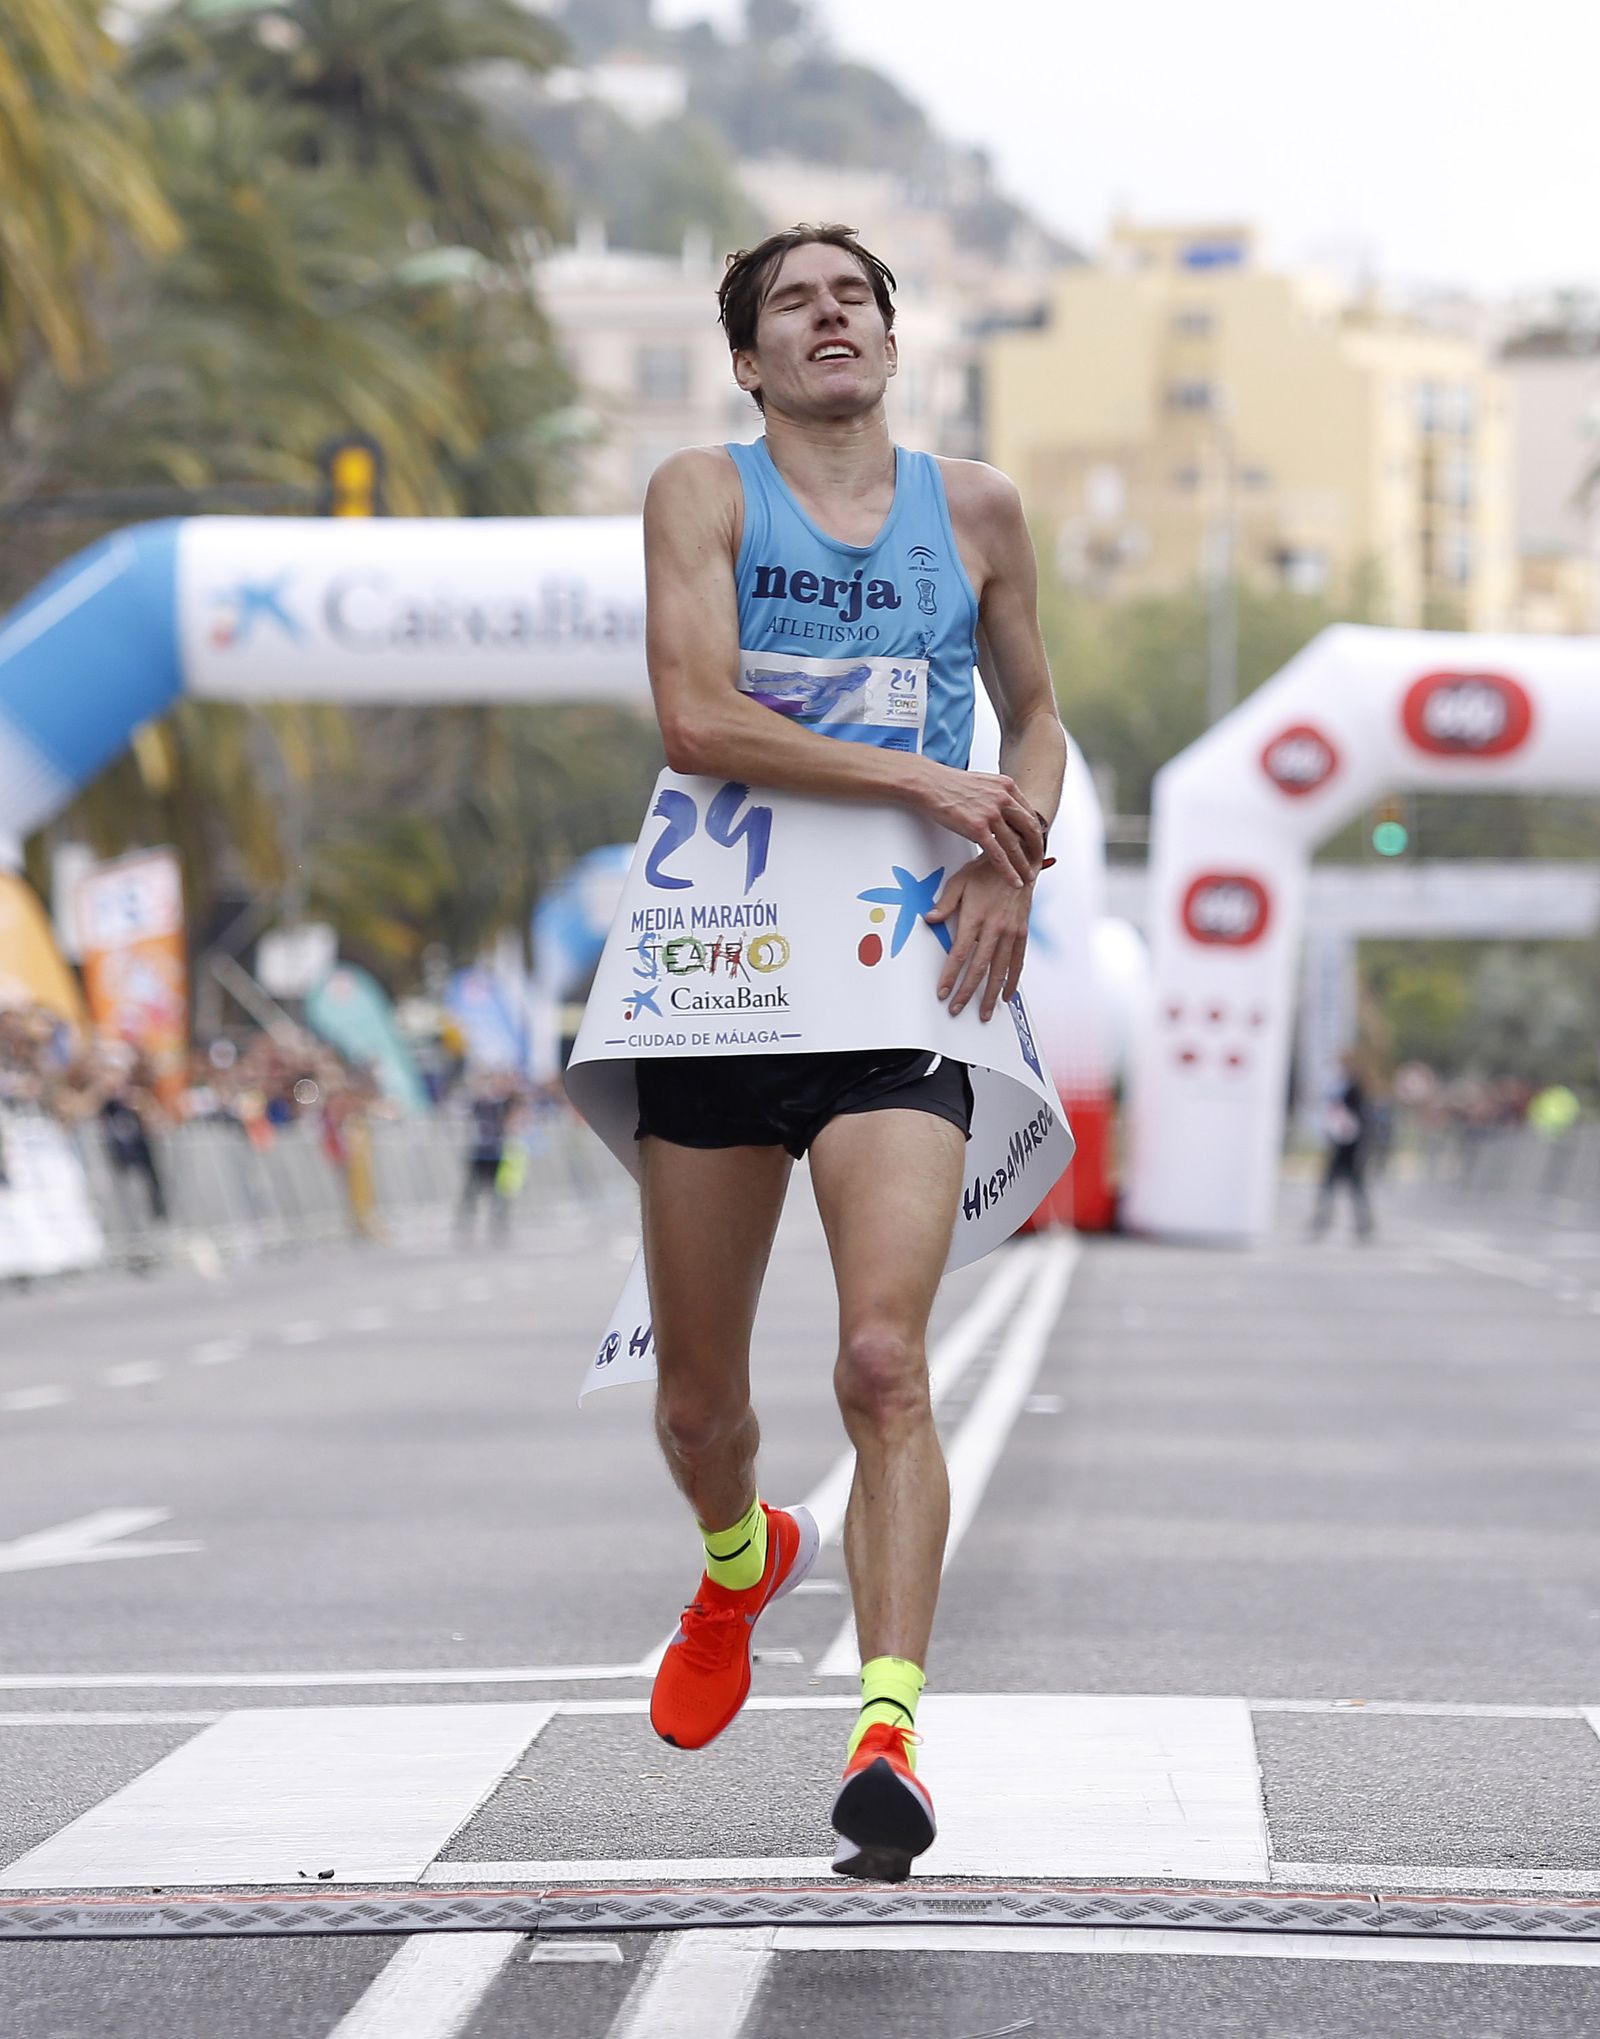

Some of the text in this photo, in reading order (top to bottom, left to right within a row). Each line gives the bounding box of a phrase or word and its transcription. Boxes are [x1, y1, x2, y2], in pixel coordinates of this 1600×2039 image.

[321, 566, 647, 652] CaixaBa
[751, 565, 902, 623] nerja
[766, 615, 880, 642] ATLETISMO
[631, 899, 778, 932] MEDIA MARATÓN
[670, 985, 790, 1011] CaixaBank
[628, 1028, 780, 1047] CIUDAD DE MÁLAGA
